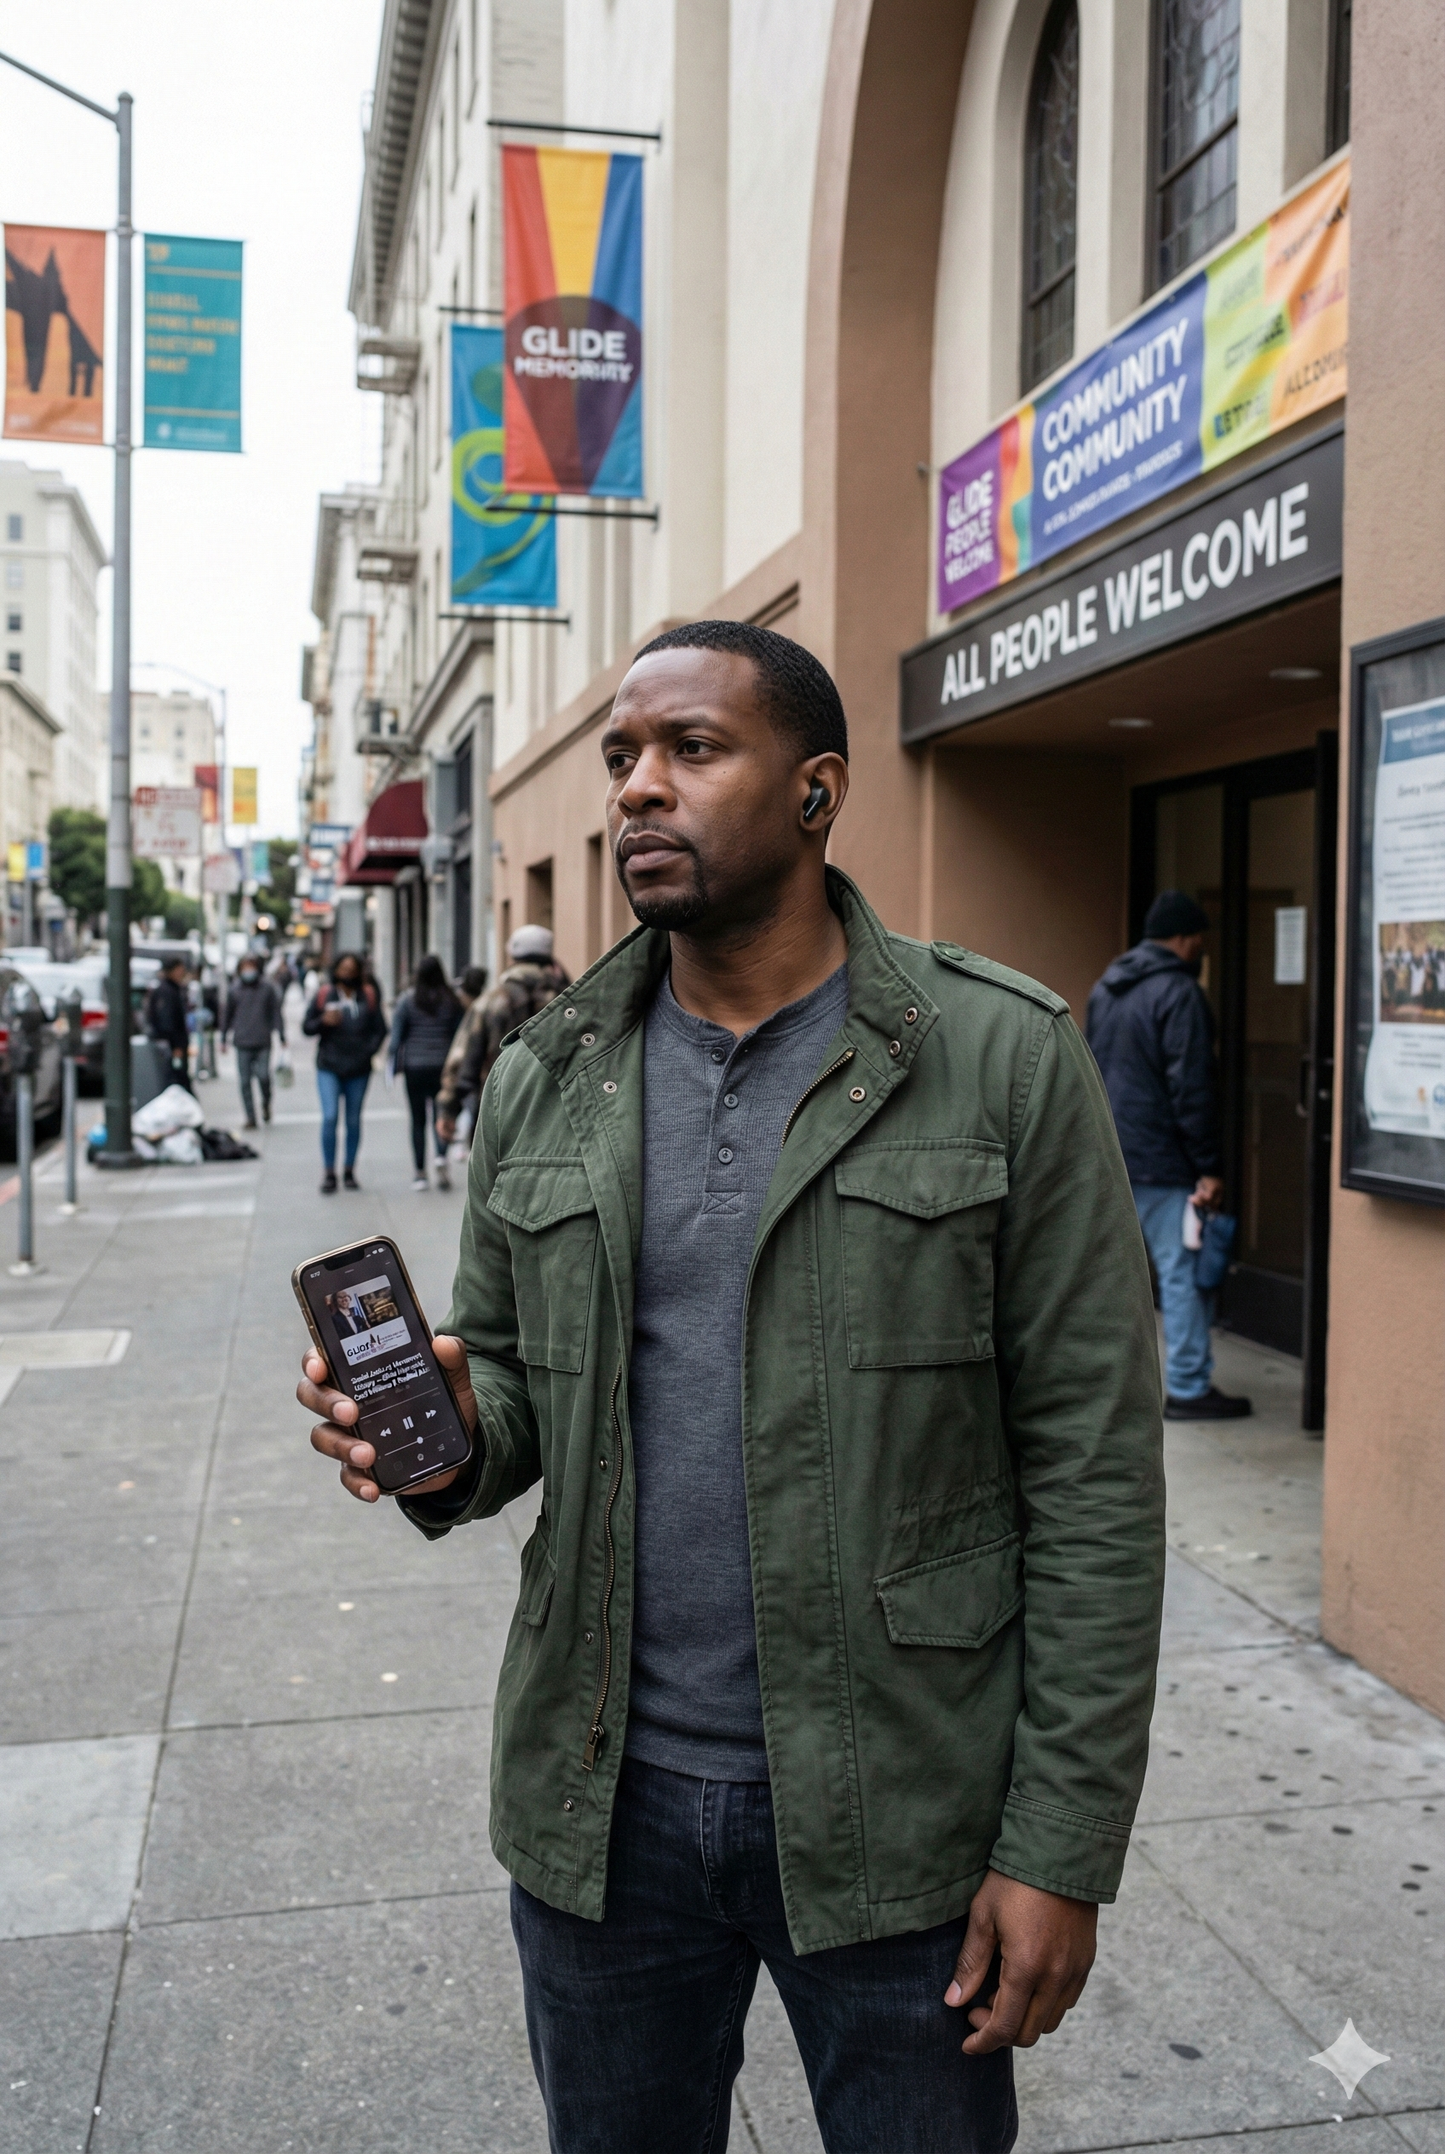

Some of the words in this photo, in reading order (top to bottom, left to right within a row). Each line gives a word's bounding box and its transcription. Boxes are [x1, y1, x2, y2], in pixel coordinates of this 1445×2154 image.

[522, 325, 627, 360] GLIDE
[1042, 317, 1189, 453] COMMUNITY
[946, 470, 994, 530] GLIDE
[1042, 374, 1188, 501] COMMUNITY
[941, 643, 986, 705] ALL
[990, 585, 1098, 684] PEOPLE
[1104, 482, 1309, 634] WELCOME
